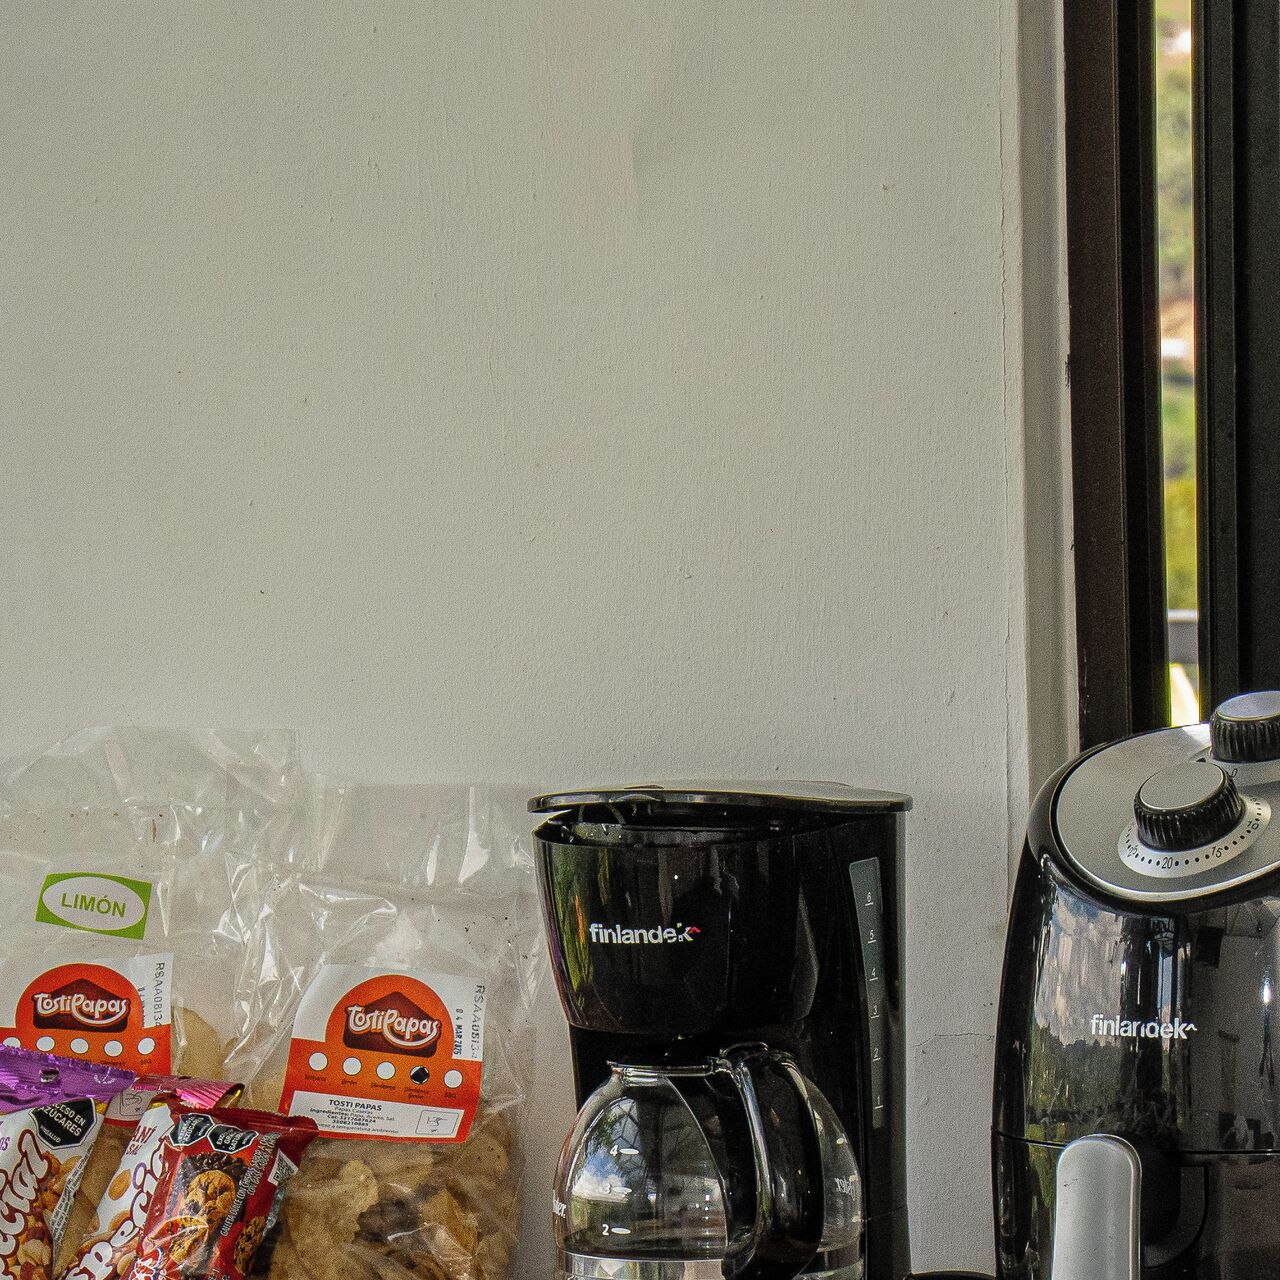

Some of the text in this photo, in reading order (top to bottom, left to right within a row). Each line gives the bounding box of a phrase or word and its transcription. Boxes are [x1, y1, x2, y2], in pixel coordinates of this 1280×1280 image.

[1247, 820, 1259, 830] 10
[1211, 846, 1224, 858] 15
[1161, 857, 1173, 869] 20
[60, 892, 127, 918] LIMÓN
[589, 923, 701, 944] finlandek
[329, 1100, 382, 1111] TOSTI PAPAS
[74, 1114, 86, 1127] EN
[610, 1145, 618, 1156] 4
[602, 1224, 609, 1235] 2
